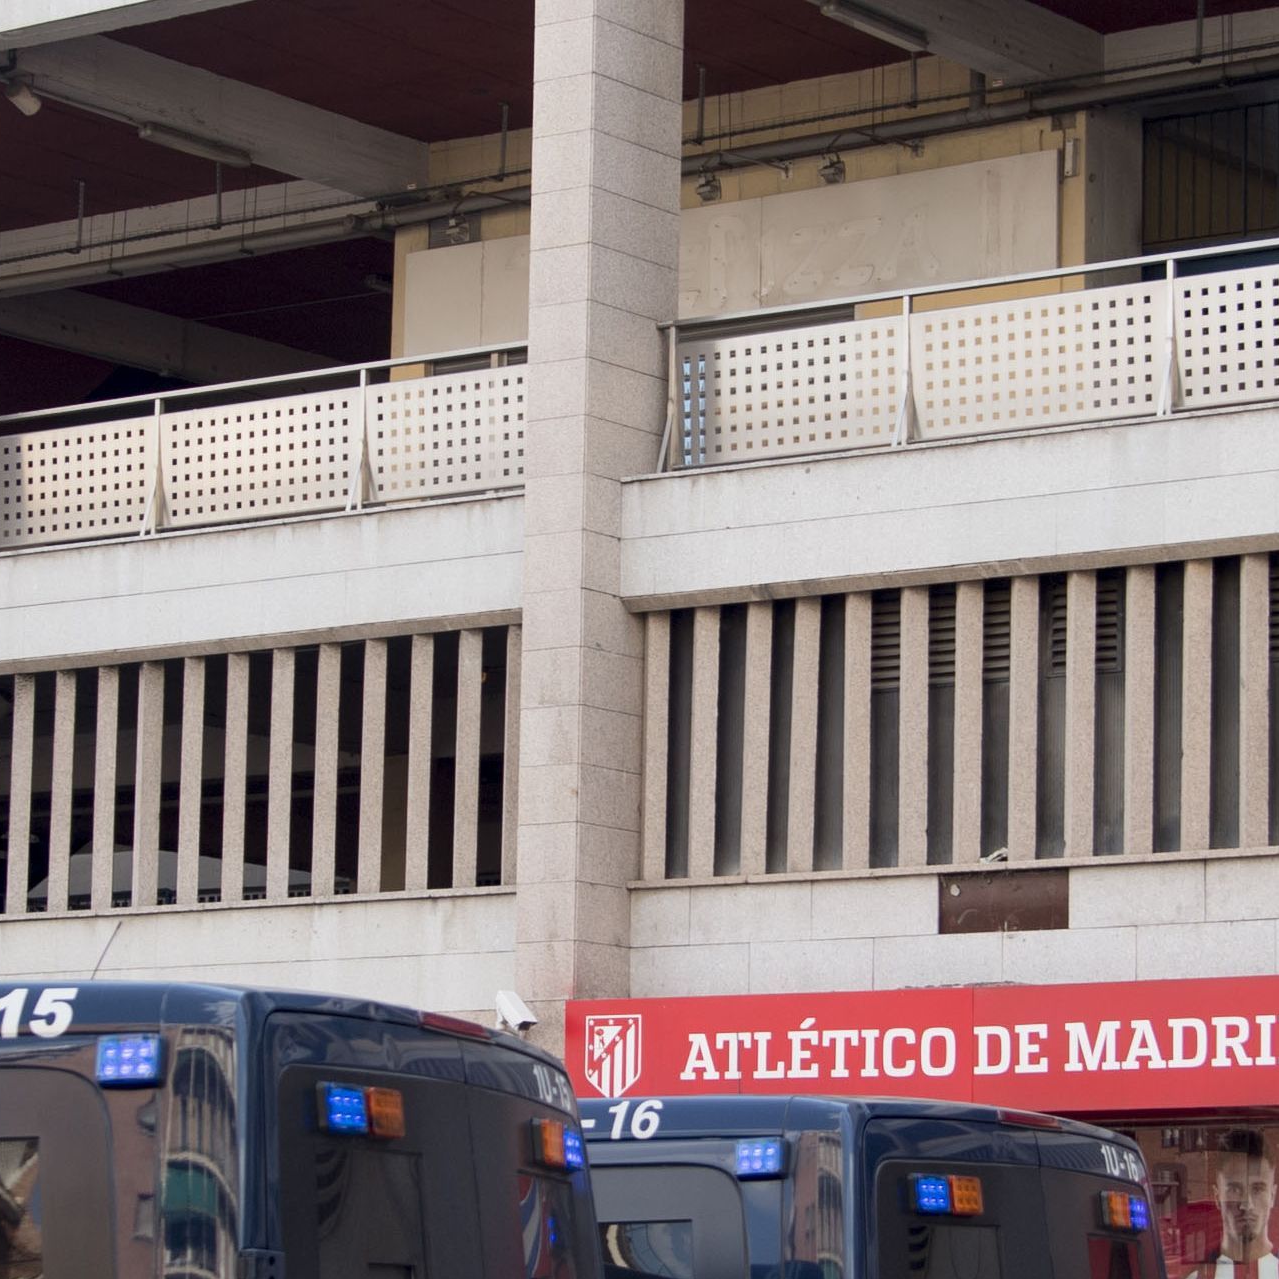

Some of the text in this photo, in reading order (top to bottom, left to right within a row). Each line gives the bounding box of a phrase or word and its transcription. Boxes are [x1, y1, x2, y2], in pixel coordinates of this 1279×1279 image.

[680, 1017, 957, 1082] ATLÉTICO
[973, 1023, 1049, 1075] DE
[581, 1099, 664, 1140] -16
[1101, 1143, 1139, 1183] 1U-16
